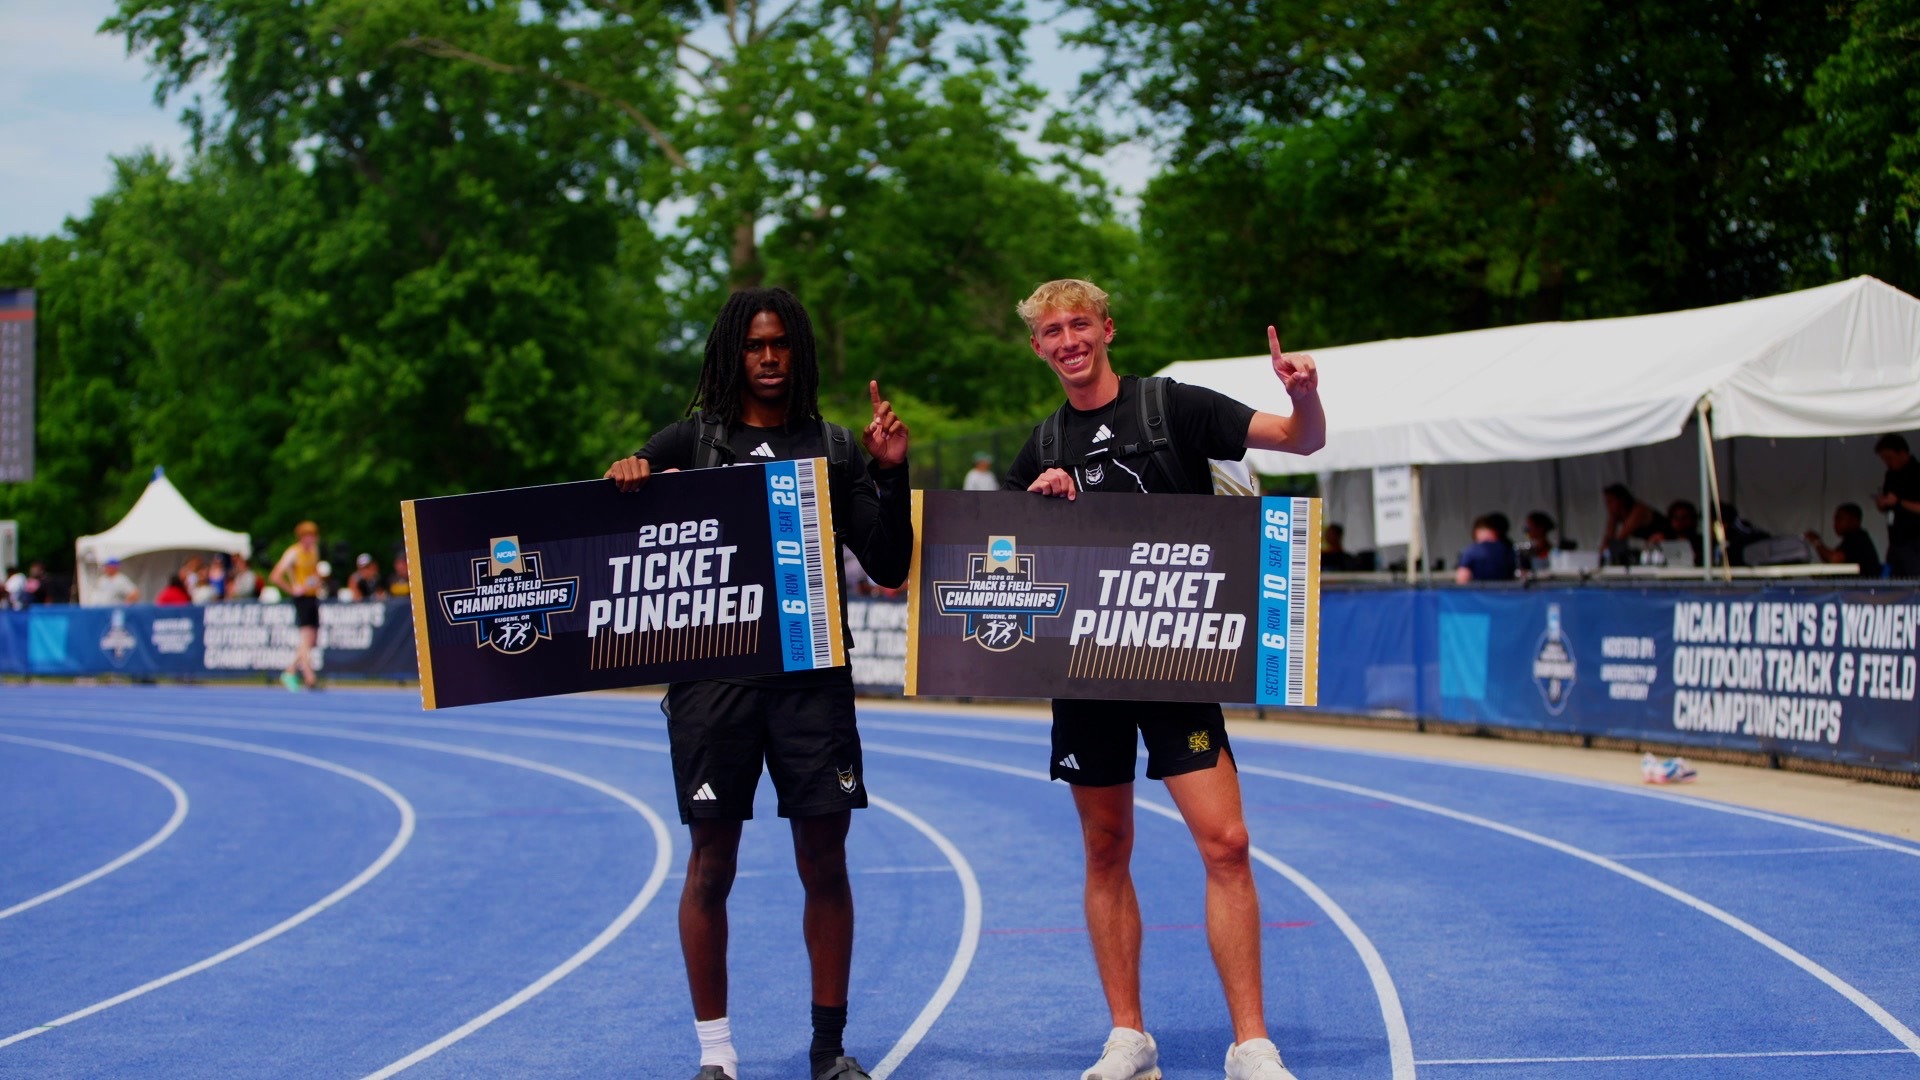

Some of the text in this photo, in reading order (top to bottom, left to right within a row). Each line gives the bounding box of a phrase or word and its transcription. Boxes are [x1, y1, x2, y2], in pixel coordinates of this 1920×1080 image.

[638, 518, 719, 548] 2026
[496, 550, 517, 559] NCAA
[608, 545, 738, 594] TICKET
[770, 474, 807, 662] SECTION 6 ROW 10 SEAT 26
[992, 549, 1013, 557] NCAA
[1129, 542, 1211, 566] 2026
[453, 587, 568, 615] CHAMPIONSHIPS
[476, 579, 542, 596] TRACK & FIELD
[945, 591, 1057, 608] CHAMPIONSHIPS
[969, 580, 1032, 591] TRACK & FIELD
[1098, 569, 1226, 609] TICKET
[1261, 508, 1289, 696] SECTION 6 ROW 10 SEAT 26
[494, 615, 520, 624] EUGENE,
[587, 583, 764, 638] PUNCHED
[1672, 601, 1727, 643] NCAA
[1755, 602, 1818, 646] MEN'S
[1821, 602, 1838, 647] &
[1069, 609, 1247, 650] PUNCHED
[1672, 646, 1917, 701] OUTDOOR TRACK & FIELD
[1672, 689, 1843, 744] CHAMPIONSHIPS
